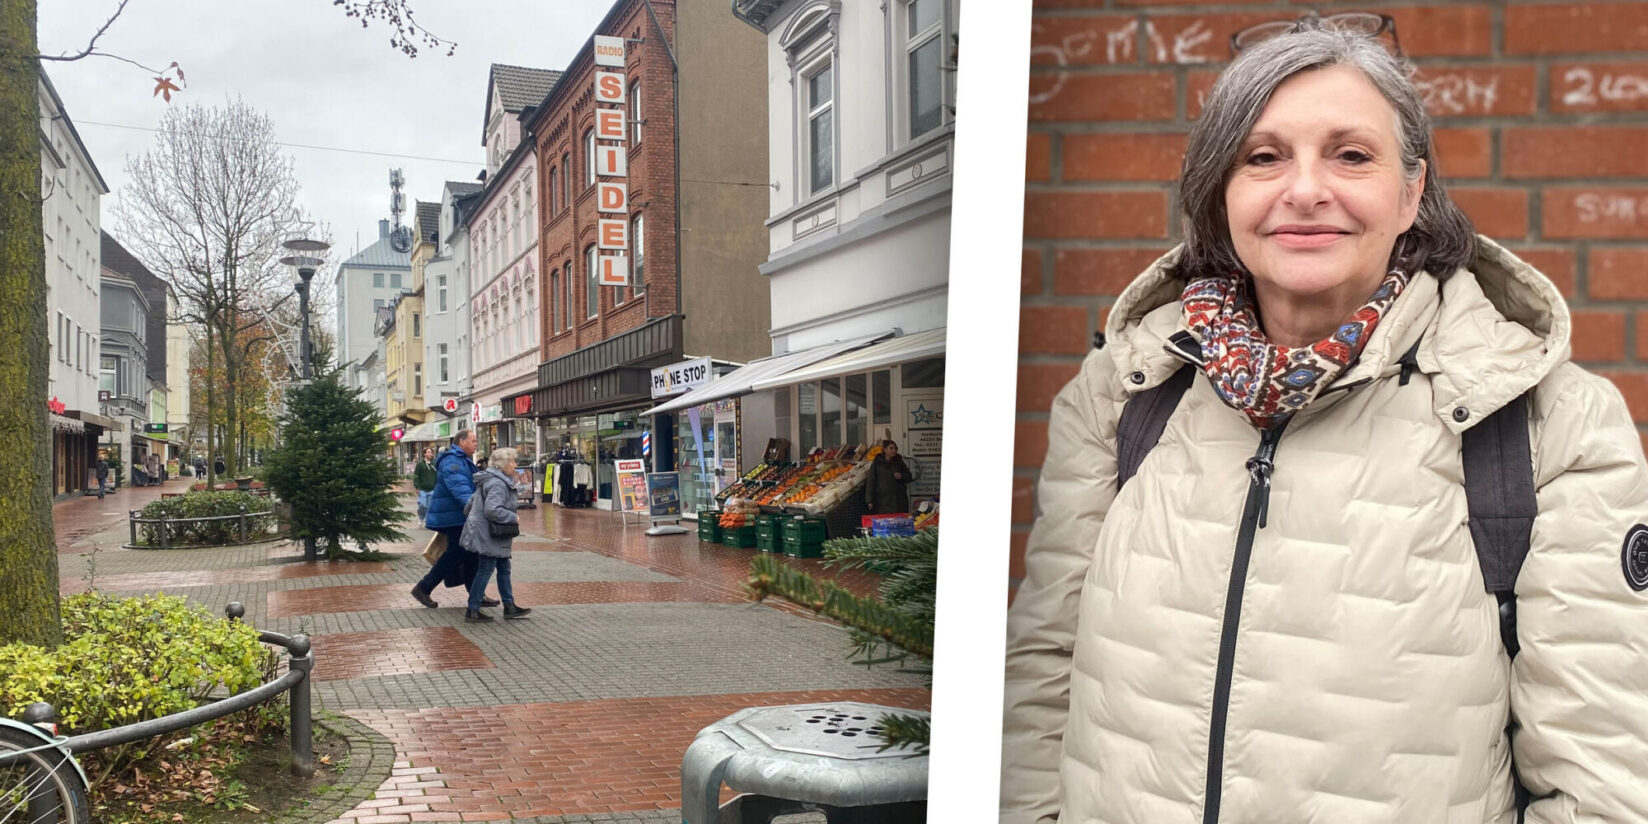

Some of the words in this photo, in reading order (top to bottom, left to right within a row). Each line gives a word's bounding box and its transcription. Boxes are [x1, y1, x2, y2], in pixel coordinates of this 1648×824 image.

[596, 44, 624, 58] RADIO
[599, 75, 625, 282] SEIDEL
[683, 365, 706, 383] STOP
